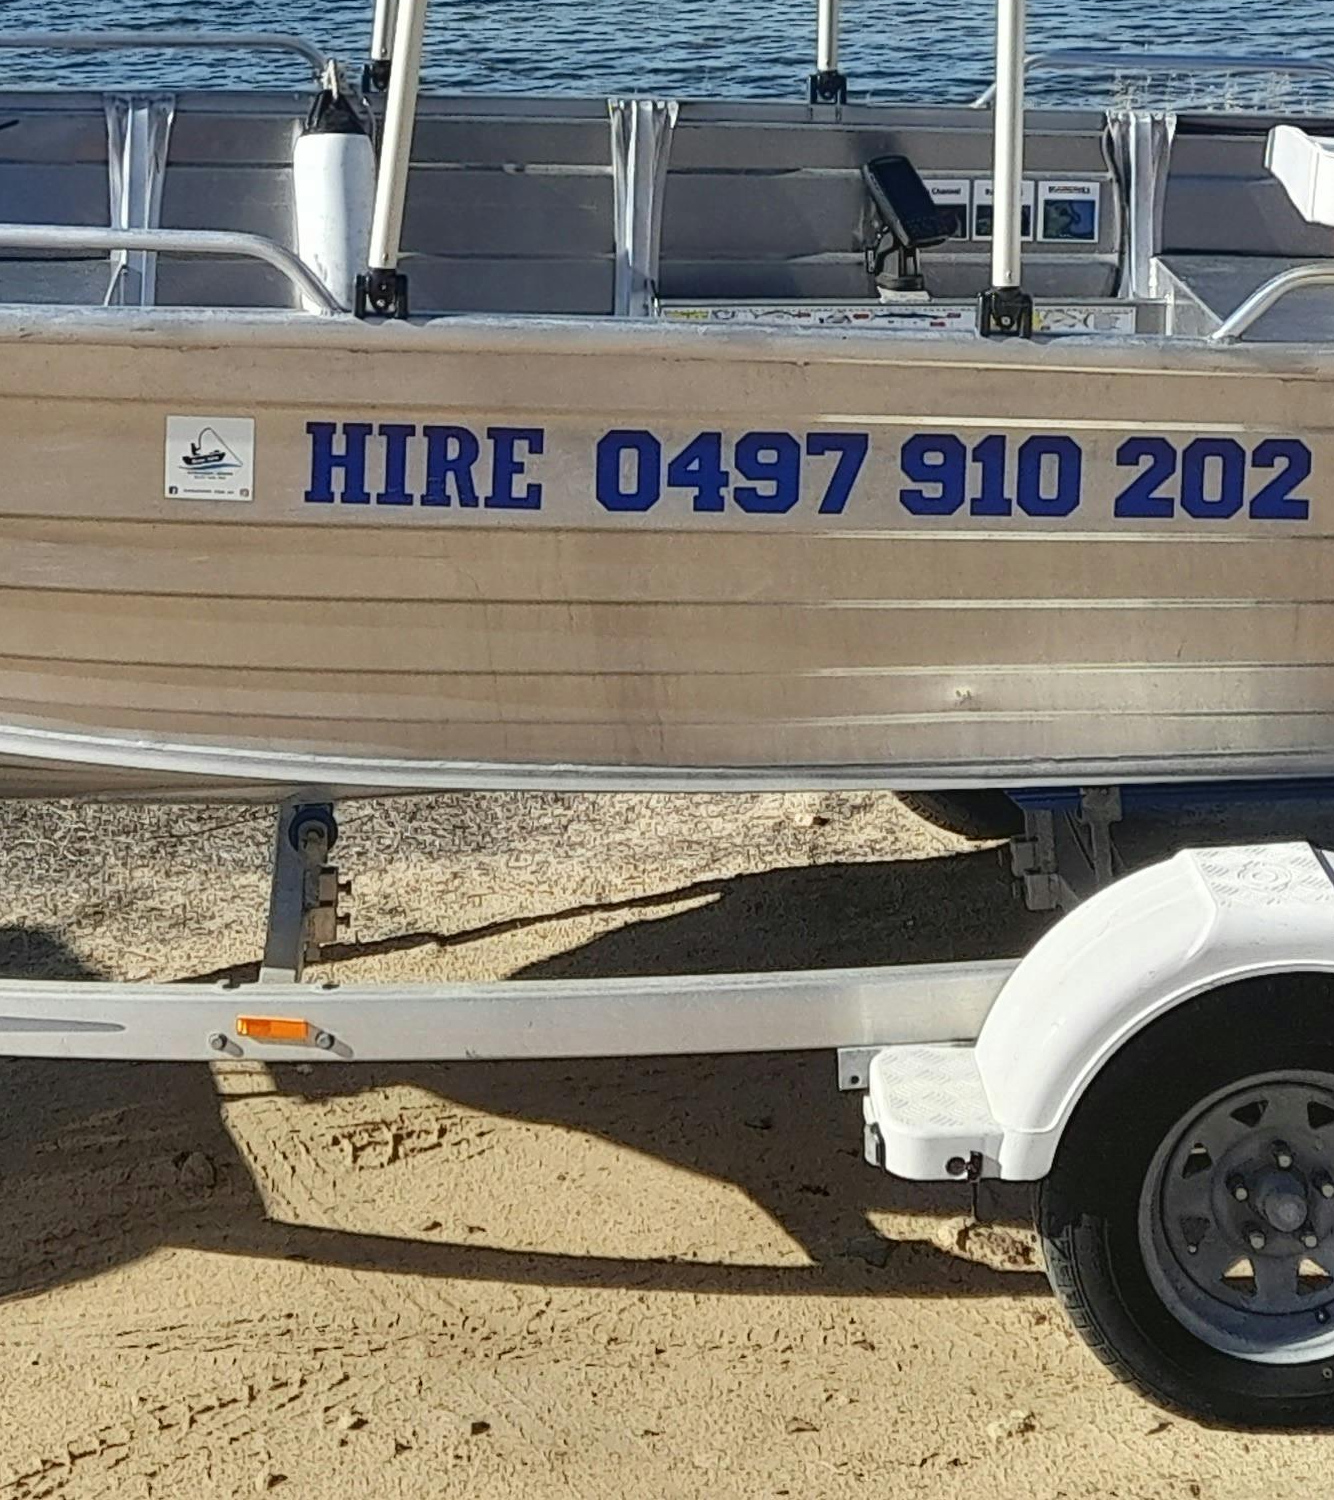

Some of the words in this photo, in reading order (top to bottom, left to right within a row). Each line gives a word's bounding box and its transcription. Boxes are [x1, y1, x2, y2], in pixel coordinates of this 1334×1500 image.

[304, 421, 544, 510] HIRE
[596, 429, 869, 515] 0497
[899, 433, 1082, 517] 910
[1113, 436, 1312, 520] 202
